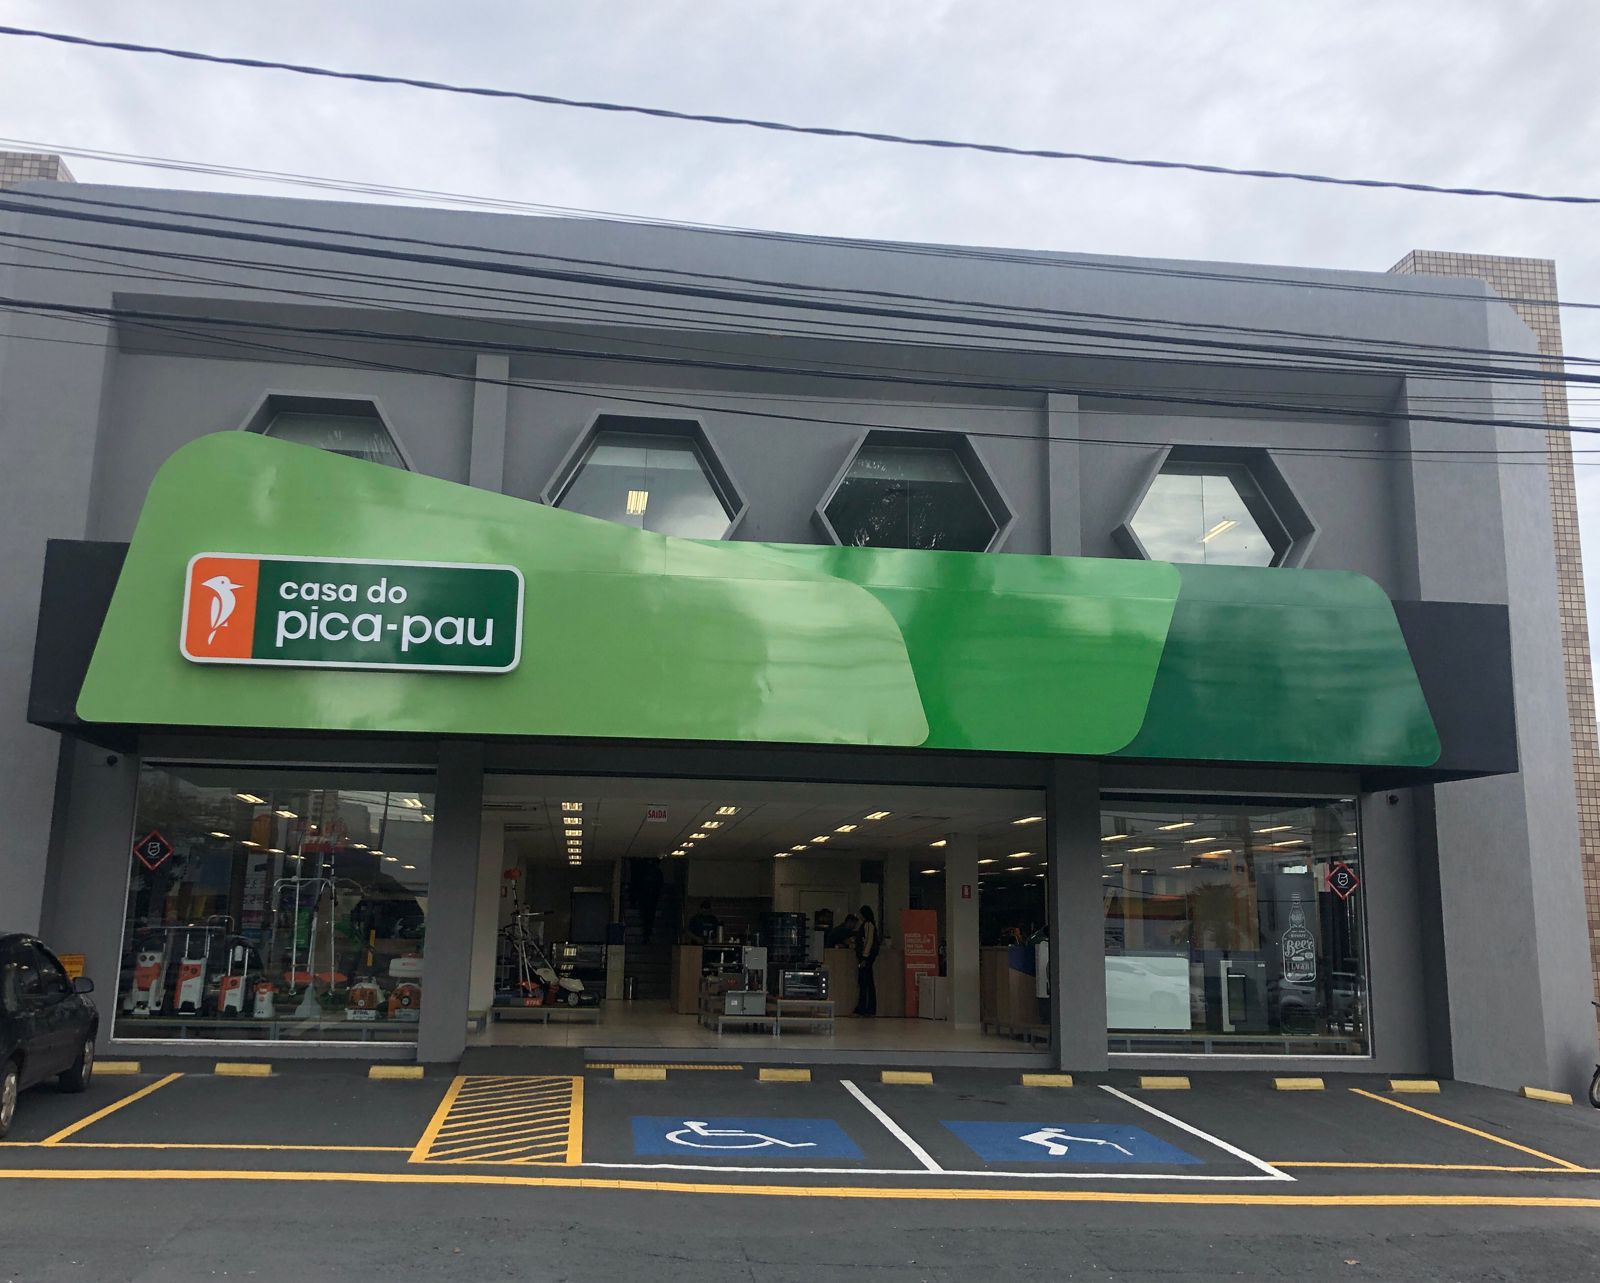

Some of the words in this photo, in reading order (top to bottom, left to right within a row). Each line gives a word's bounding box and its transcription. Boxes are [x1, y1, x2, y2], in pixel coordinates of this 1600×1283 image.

[279, 581, 357, 602] casa
[367, 577, 407, 604] do
[275, 606, 494, 652] pica-pau
[1285, 939, 1314, 957] Beer
